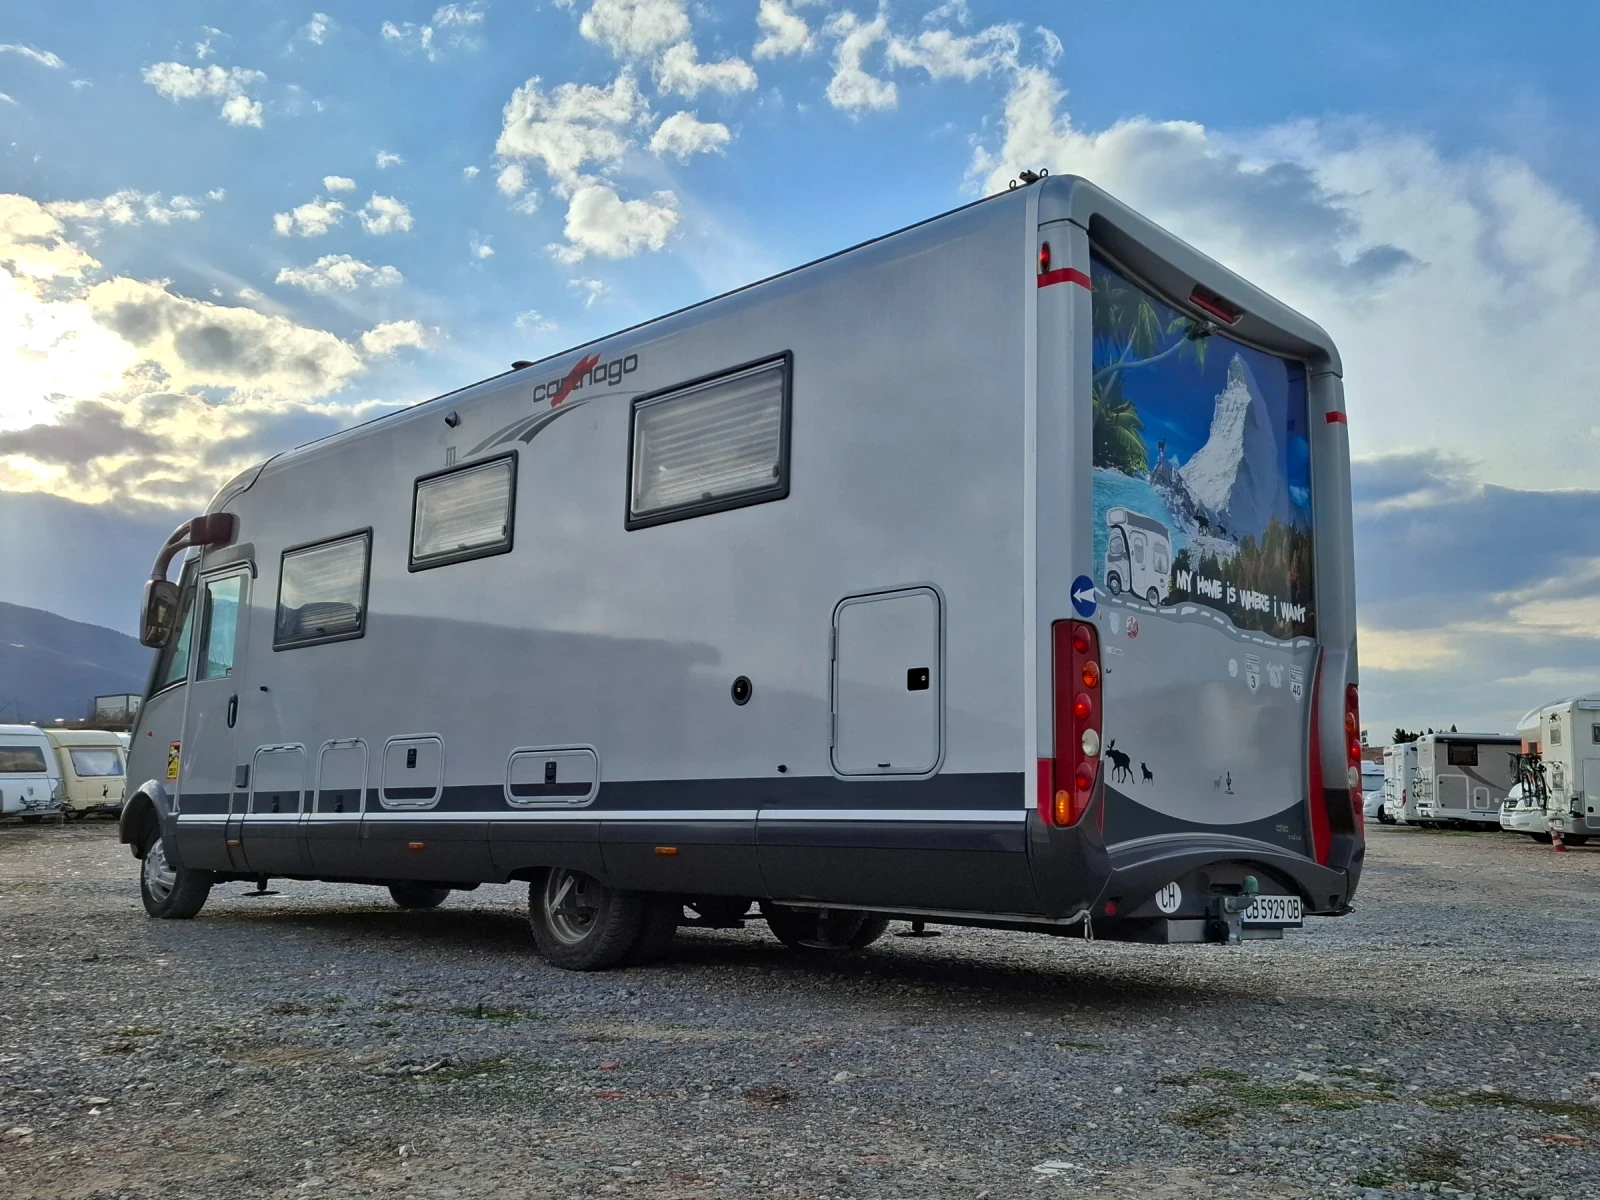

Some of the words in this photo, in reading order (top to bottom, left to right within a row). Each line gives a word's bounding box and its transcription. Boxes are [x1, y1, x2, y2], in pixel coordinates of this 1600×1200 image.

[1177, 569, 1193, 593] MY
[1196, 575, 1222, 599] HOME
[1239, 589, 1270, 612] WHERE
[1280, 601, 1306, 623] WANT
[1250, 675, 1256, 688] 3
[1292, 684, 1301, 696] 40
[1161, 883, 1176, 908] CH
[1260, 899, 1285, 920] 5929
